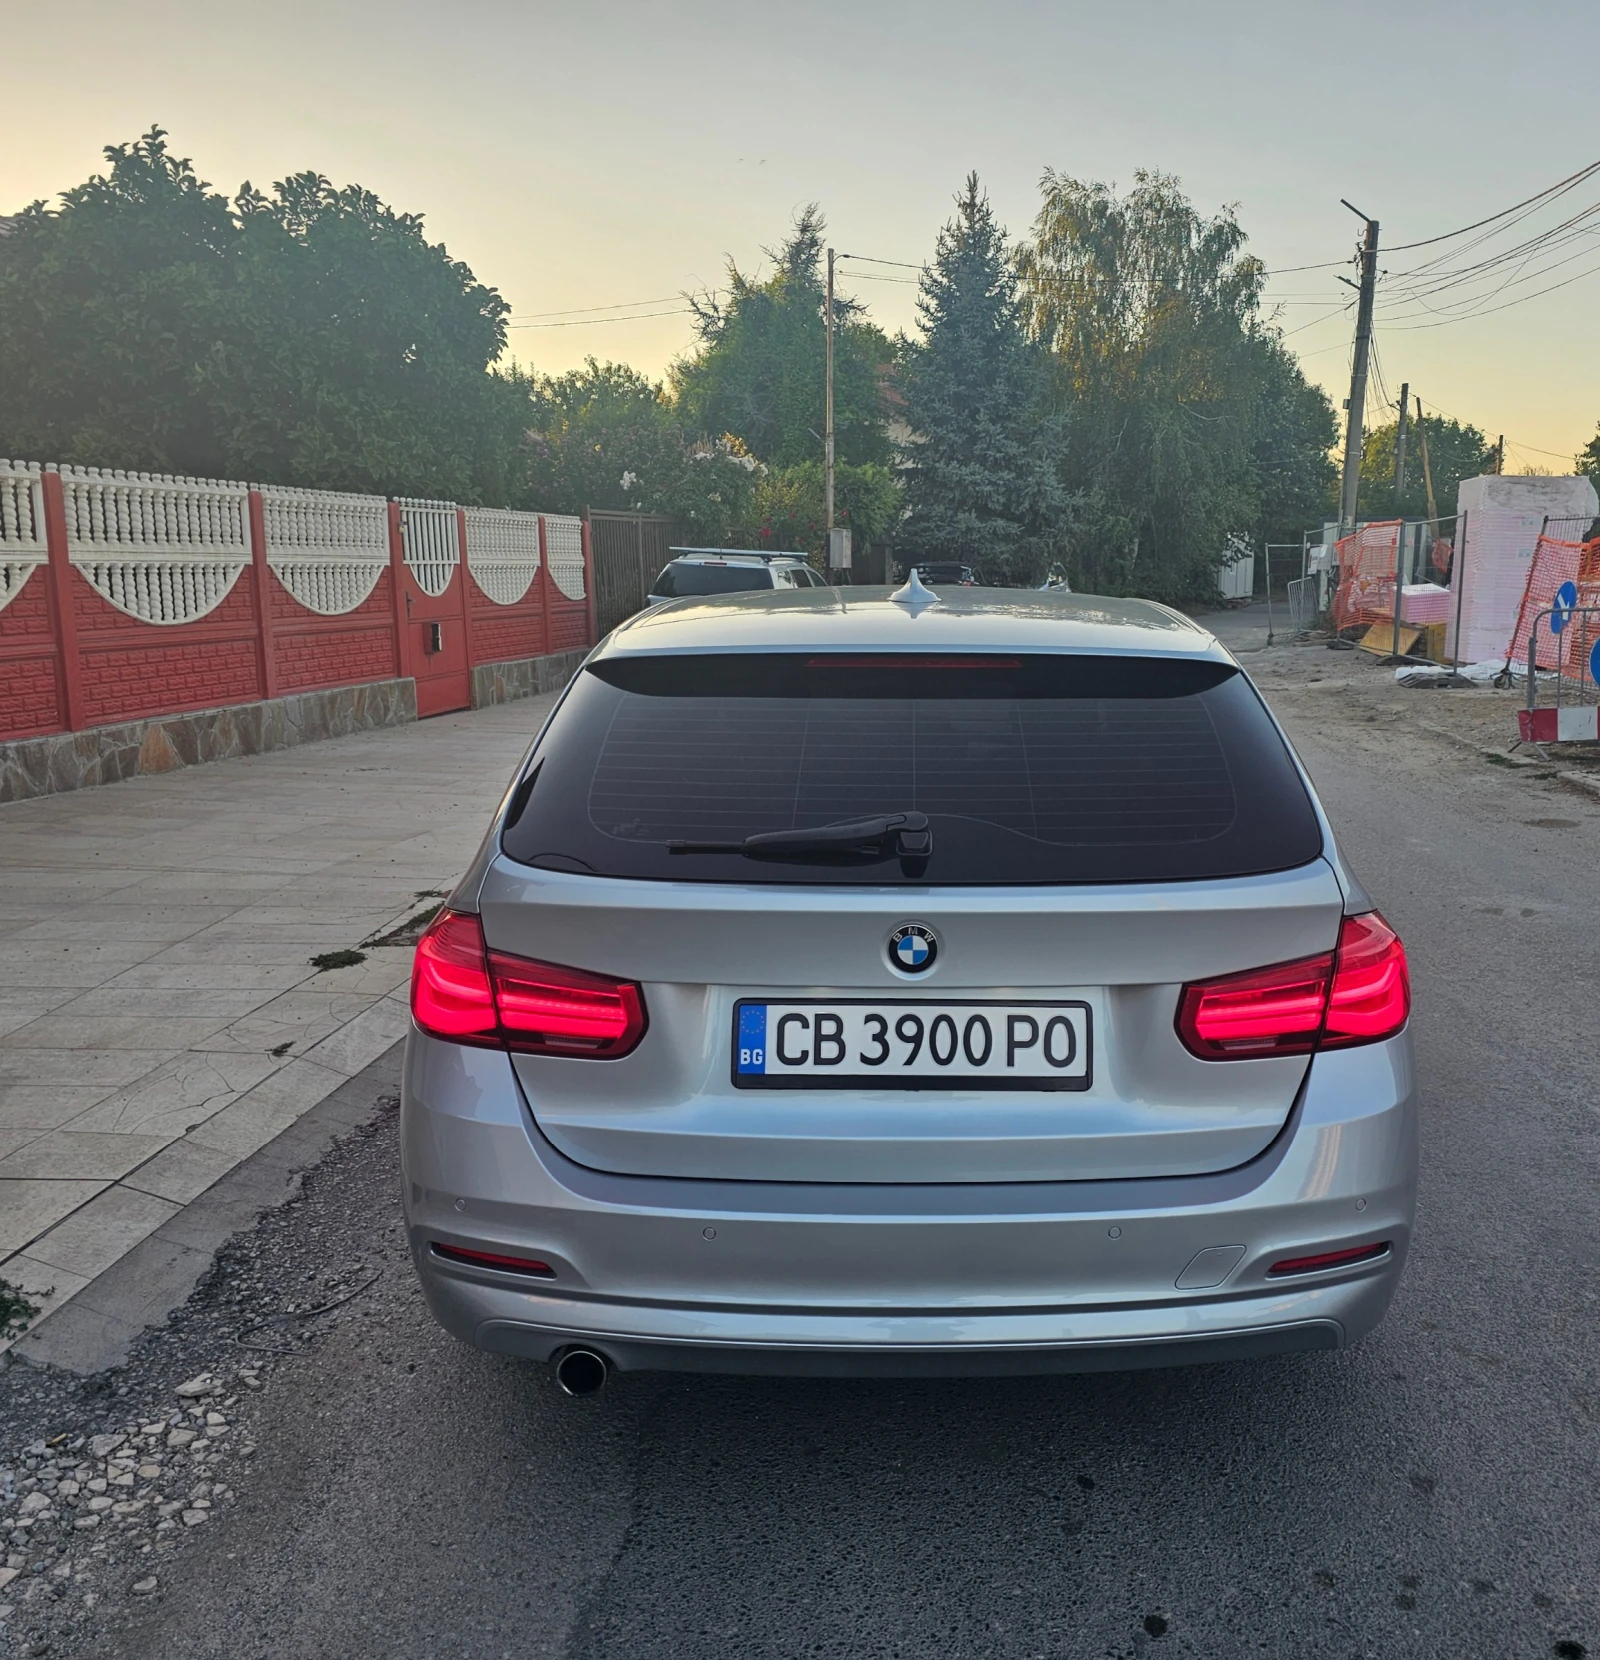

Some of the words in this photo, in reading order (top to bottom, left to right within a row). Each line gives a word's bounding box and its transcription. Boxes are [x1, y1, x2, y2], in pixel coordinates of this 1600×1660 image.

[893, 926, 934, 942] BMW
[776, 1013, 846, 1065] CB
[860, 1014, 992, 1067] 3900
[740, 1049, 763, 1065] BG
